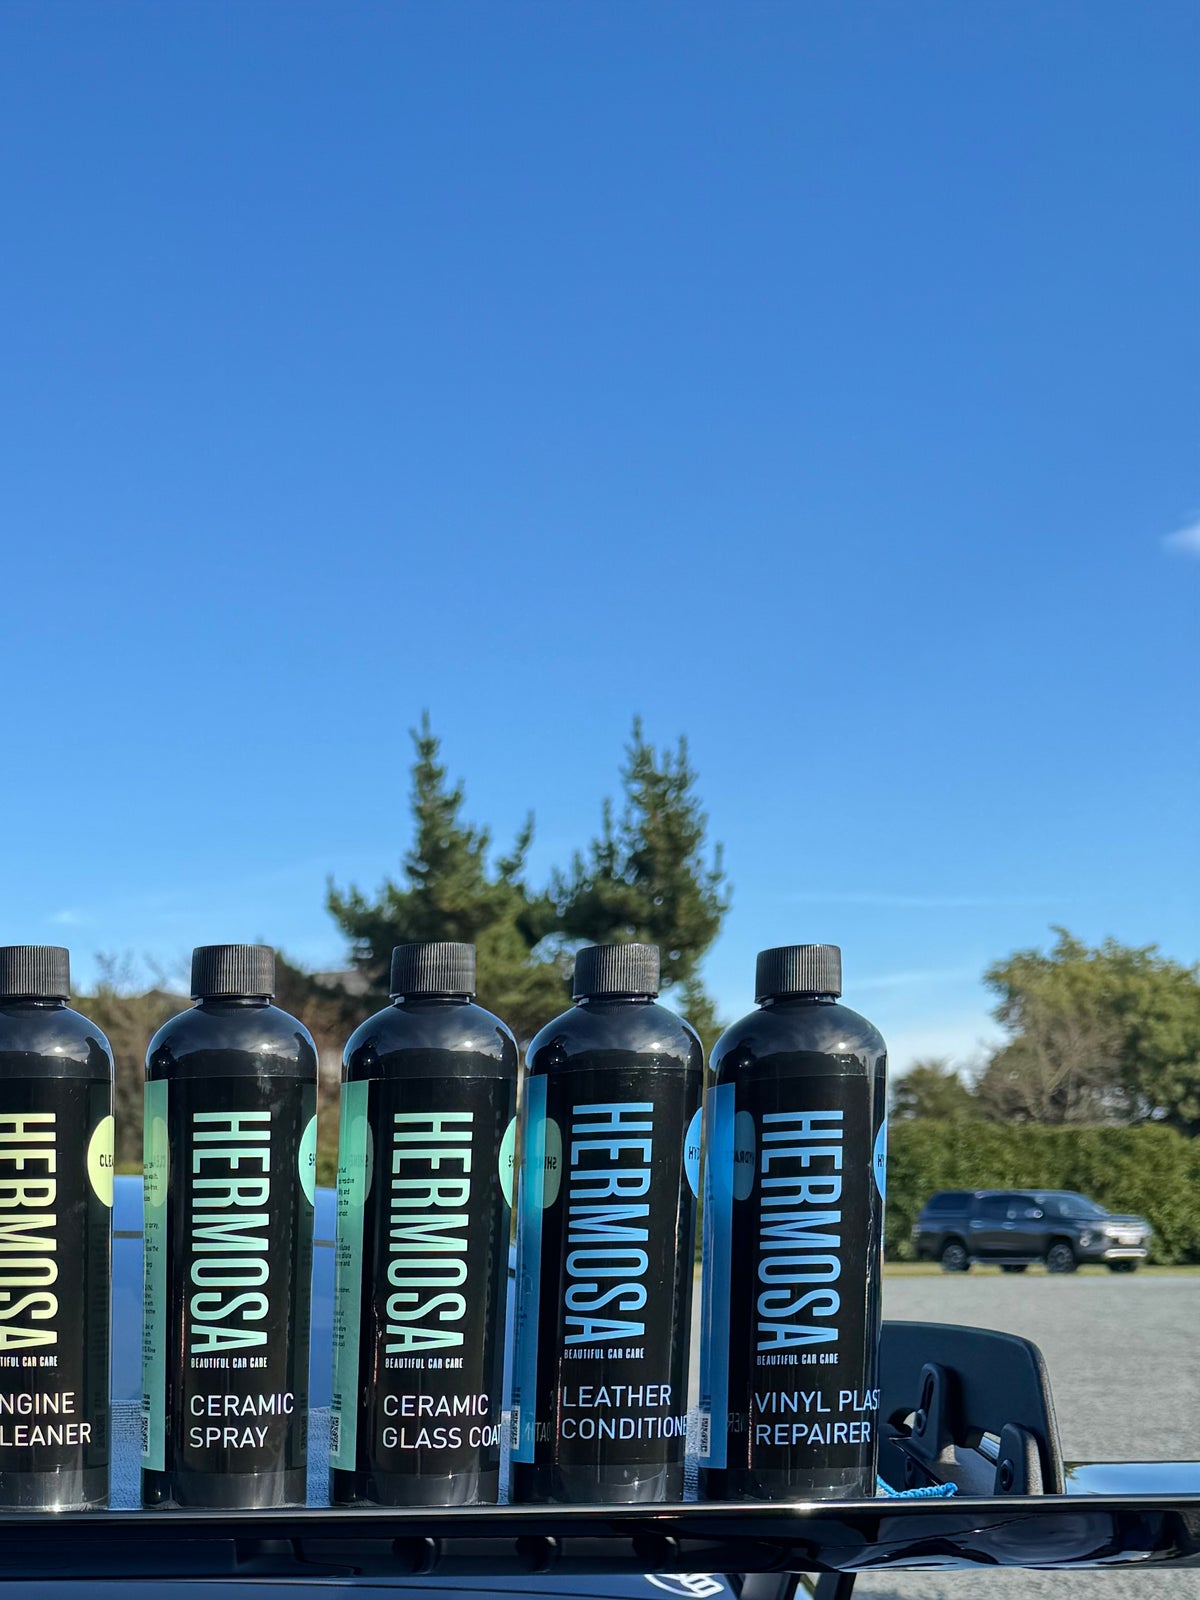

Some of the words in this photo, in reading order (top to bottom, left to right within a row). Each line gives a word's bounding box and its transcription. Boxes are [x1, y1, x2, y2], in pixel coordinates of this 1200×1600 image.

[190, 1111, 271, 1353] HERMOSA
[386, 1111, 474, 1353] HERMOSA
[564, 1102, 654, 1345] HERMOSA
[757, 1111, 844, 1351] HERMOSA
[22, 1357, 37, 1366] CAR
[39, 1356, 58, 1366] CARE
[191, 1358, 230, 1368] BEAUTIFUL
[232, 1358, 247, 1368] CAR
[250, 1357, 268, 1368] CARE
[386, 1358, 425, 1368] BEAUTIFUL
[428, 1358, 442, 1368] CAR
[445, 1357, 463, 1368] CARE
[564, 1348, 605, 1358] BEAUTIFUL
[608, 1348, 622, 1358] CAR
[625, 1347, 645, 1358] CARE
[757, 1355, 798, 1364] BEAUTIFUL
[801, 1355, 816, 1364] CAR
[819, 1354, 838, 1364] CARE
[190, 1393, 294, 1416] CERAMIC
[383, 1394, 488, 1417] CERAMIC
[562, 1384, 671, 1408] LEATHER
[755, 1391, 830, 1413] VINYL
[190, 1427, 269, 1449] SPRAY
[382, 1427, 461, 1449] GLASS
[756, 1422, 870, 1445] REPAIRER
